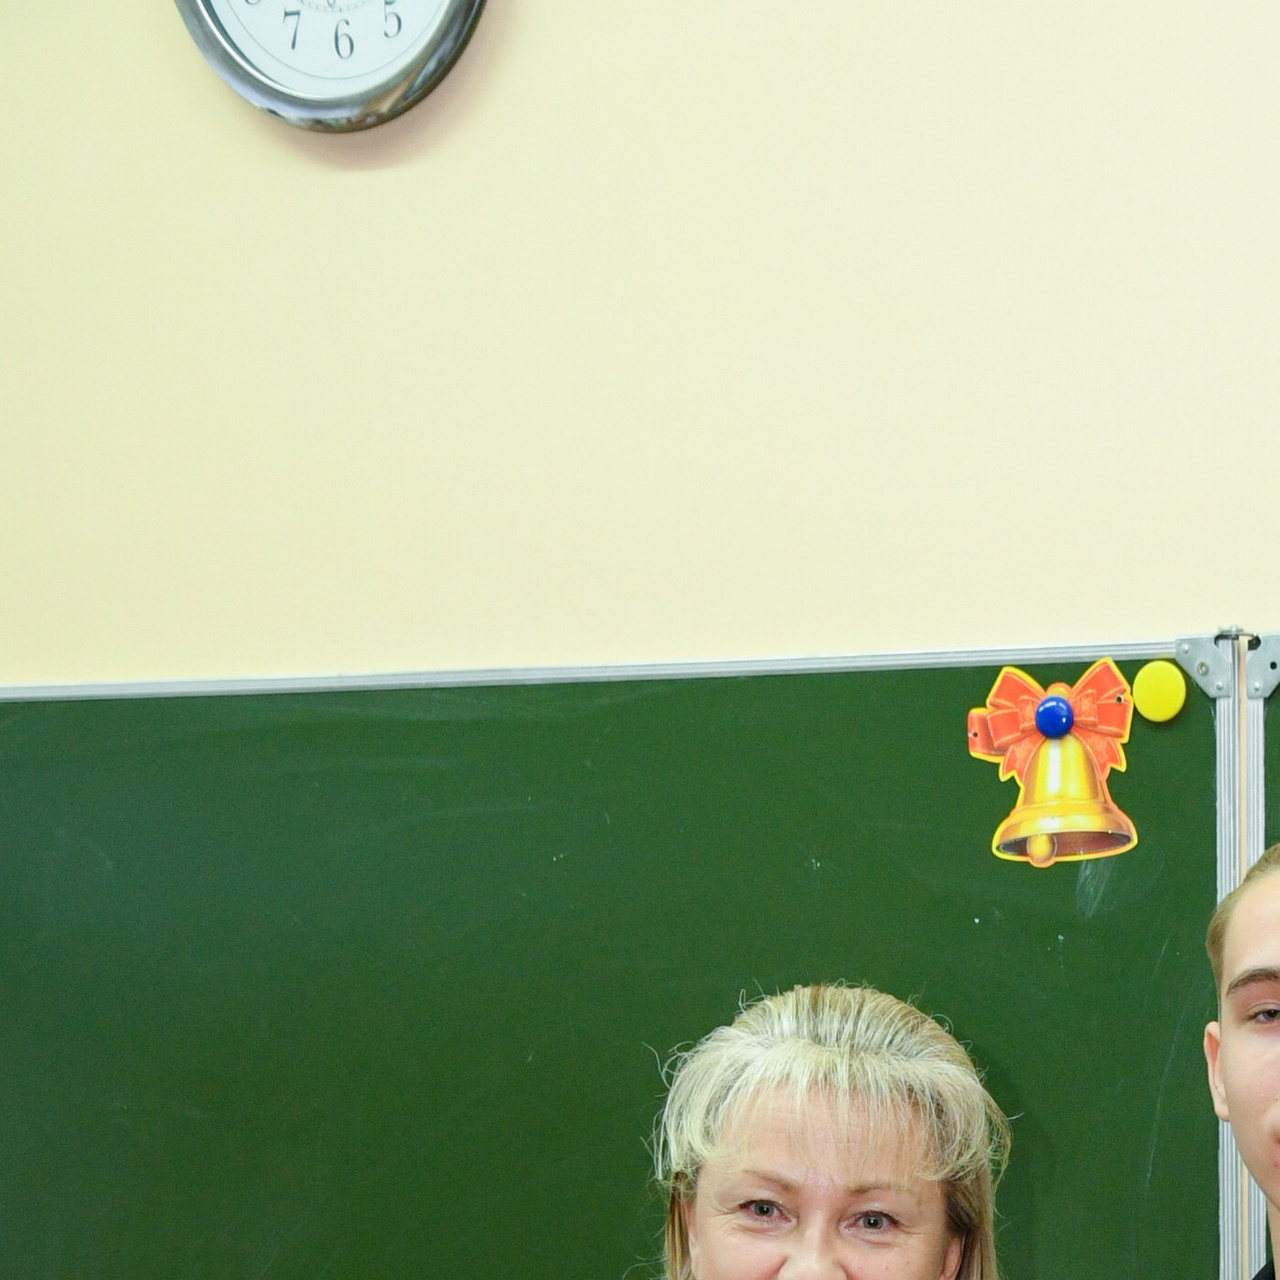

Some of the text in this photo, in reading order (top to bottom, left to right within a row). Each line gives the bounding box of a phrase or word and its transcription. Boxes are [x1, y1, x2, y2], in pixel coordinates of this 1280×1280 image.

[283, 8, 301, 50] 7
[334, 19, 354, 60] 6
[383, 0, 402, 38] 5
